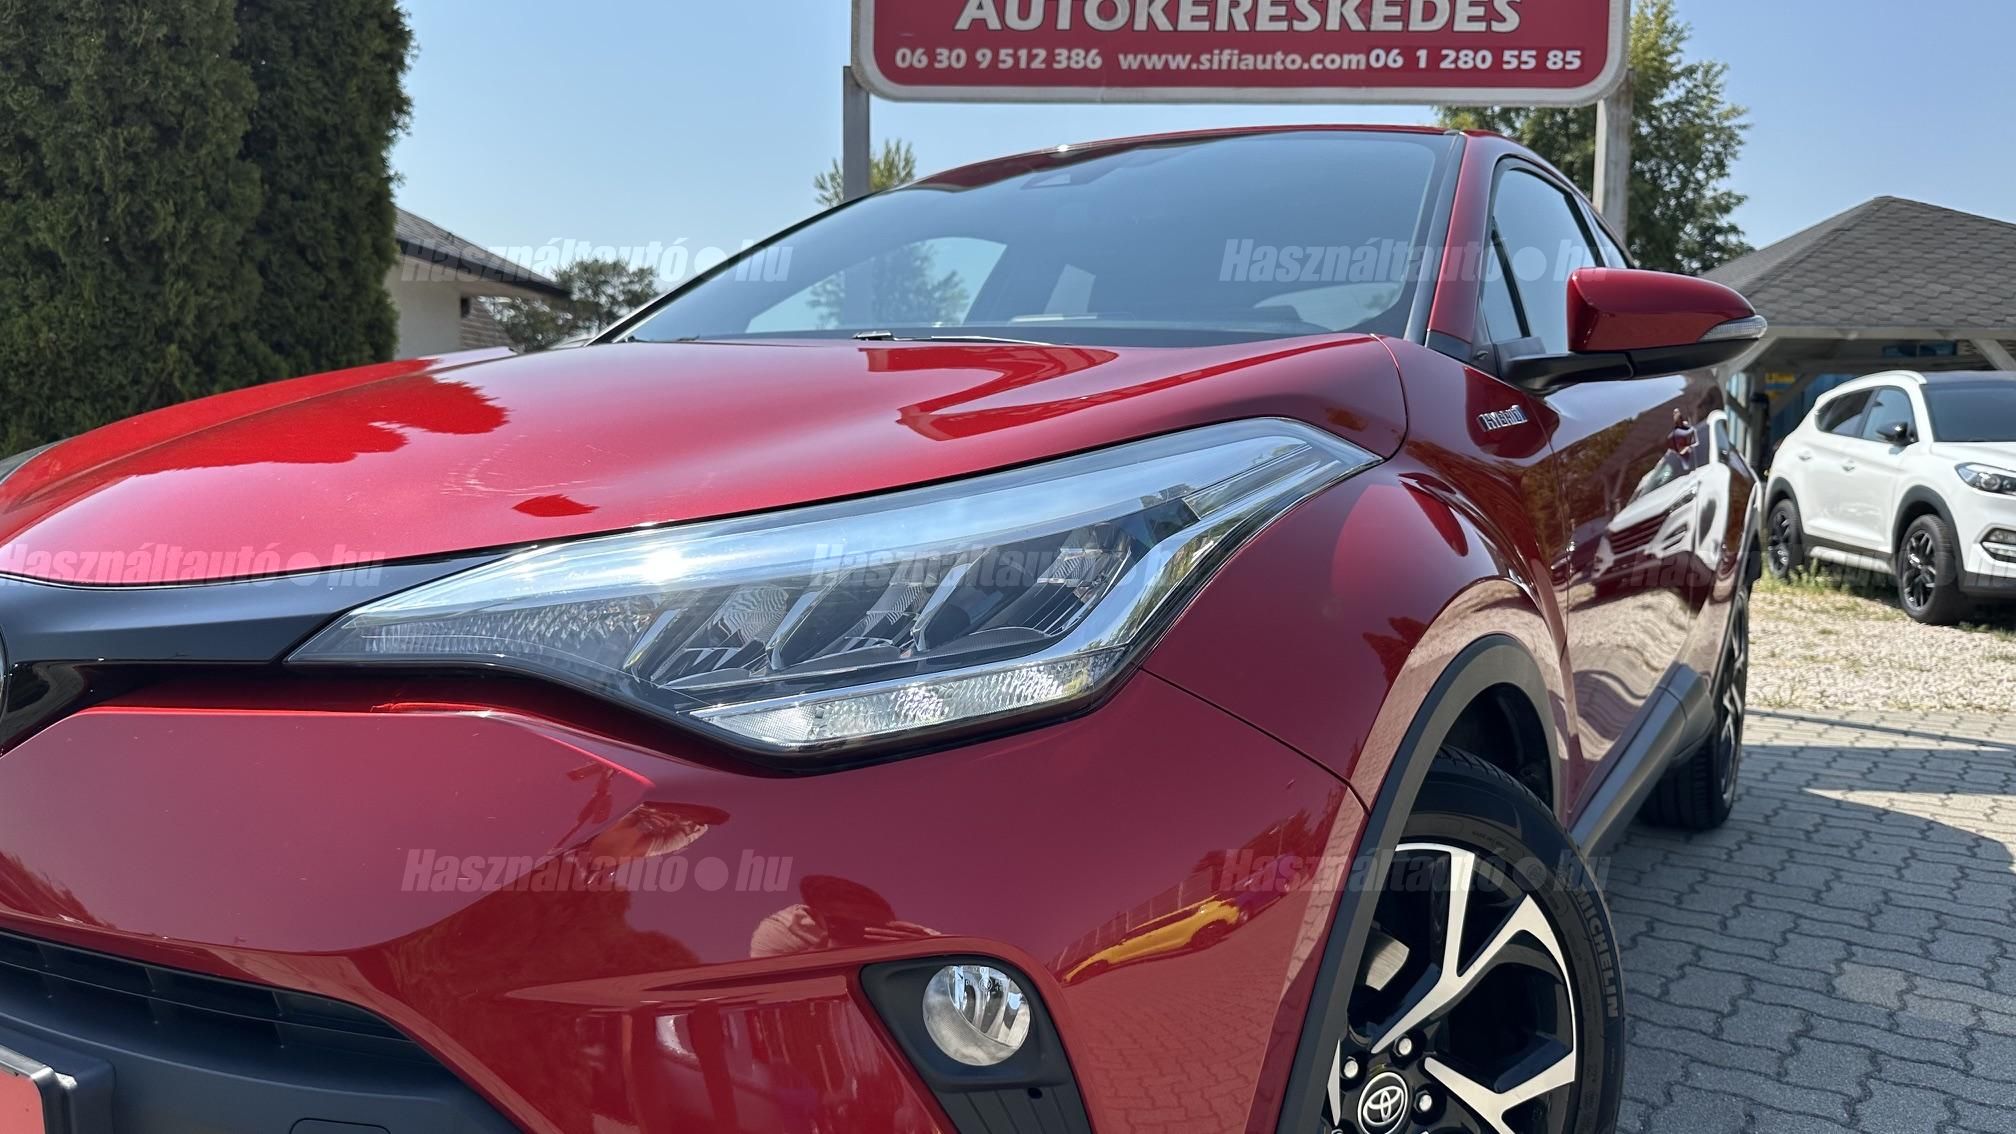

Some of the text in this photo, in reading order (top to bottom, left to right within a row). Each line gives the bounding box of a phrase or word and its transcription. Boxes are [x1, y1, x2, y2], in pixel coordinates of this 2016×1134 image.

[895, 48, 928, 69] 06
[934, 48, 967, 69] 30
[1052, 48, 1103, 69] 386
[1118, 48, 1366, 70] www.sifiauto.com
[1368, 49, 1404, 69] 06
[1415, 50, 1428, 69] 1
[1439, 50, 1493, 70] 280
[1502, 50, 1537, 70] 55
[1545, 50, 1582, 70] 85
[1477, 404, 1528, 432] HYBRID
[1573, 884, 1619, 1018] MICHELIN
